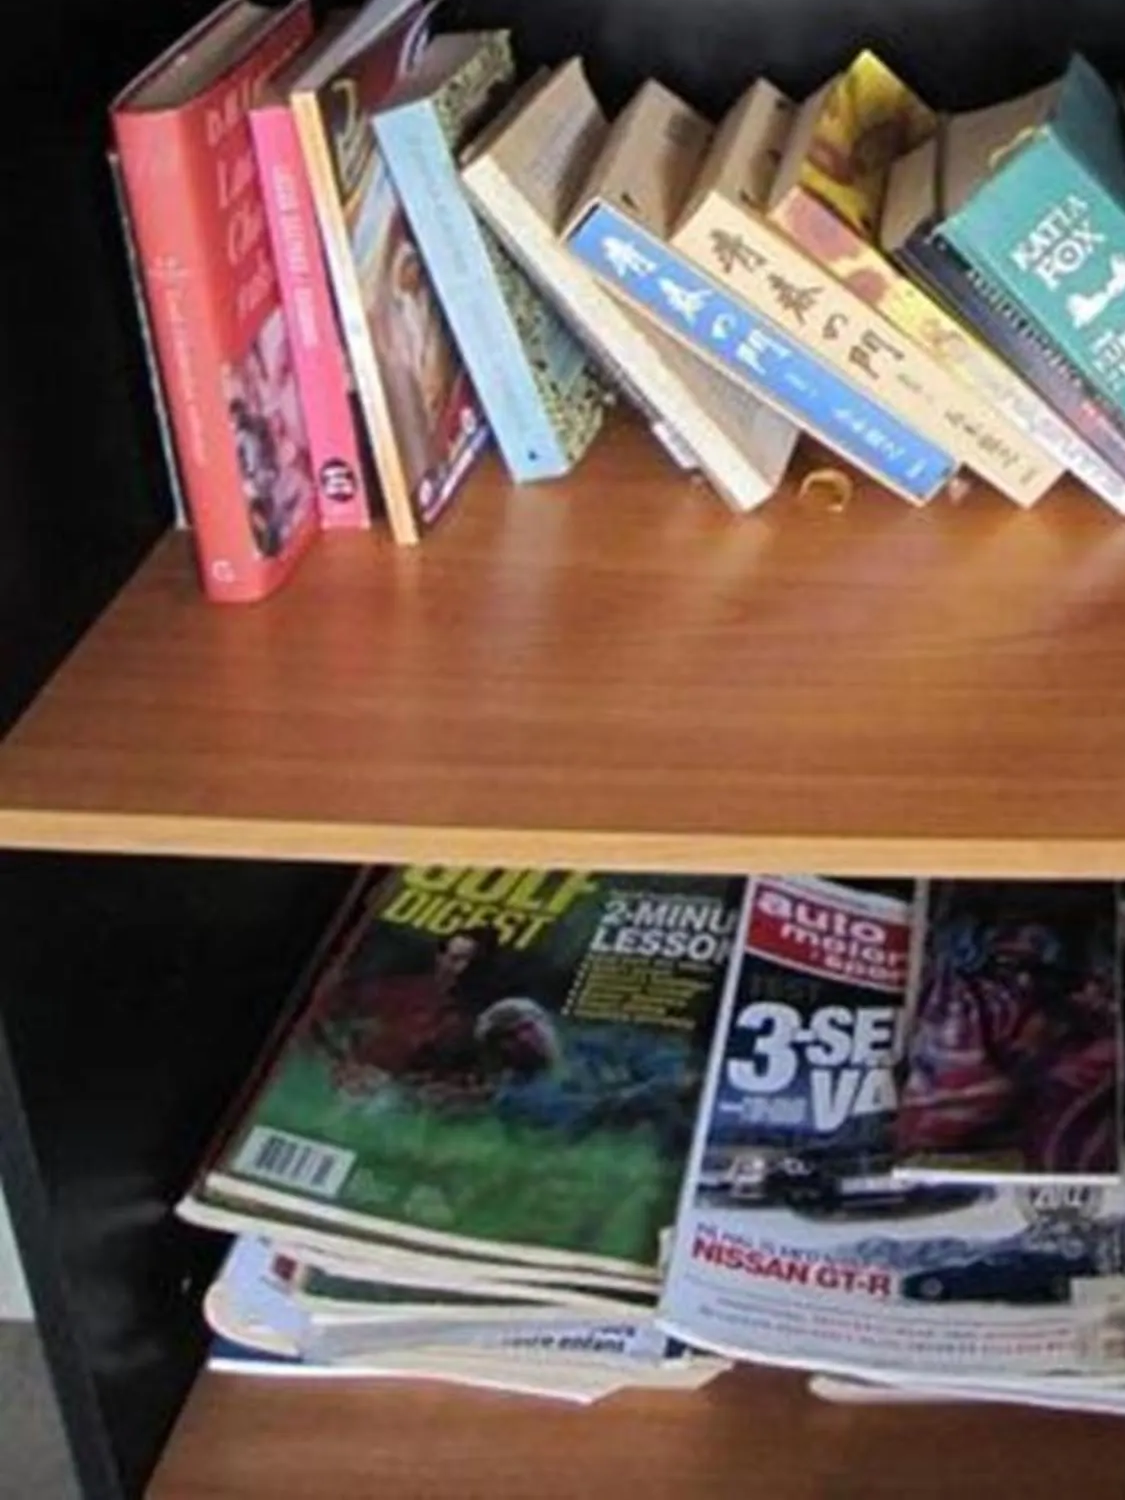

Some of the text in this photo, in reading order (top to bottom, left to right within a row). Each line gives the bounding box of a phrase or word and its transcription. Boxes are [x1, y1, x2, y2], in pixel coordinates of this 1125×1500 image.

[1036, 222, 1106, 294] FOX
[381, 889, 556, 950] DIGEST
[756, 890, 888, 944] auto
[779, 922, 907, 968] motor
[691, 1236, 811, 1286] NISSAN
[815, 1264, 893, 1298] GT-R
